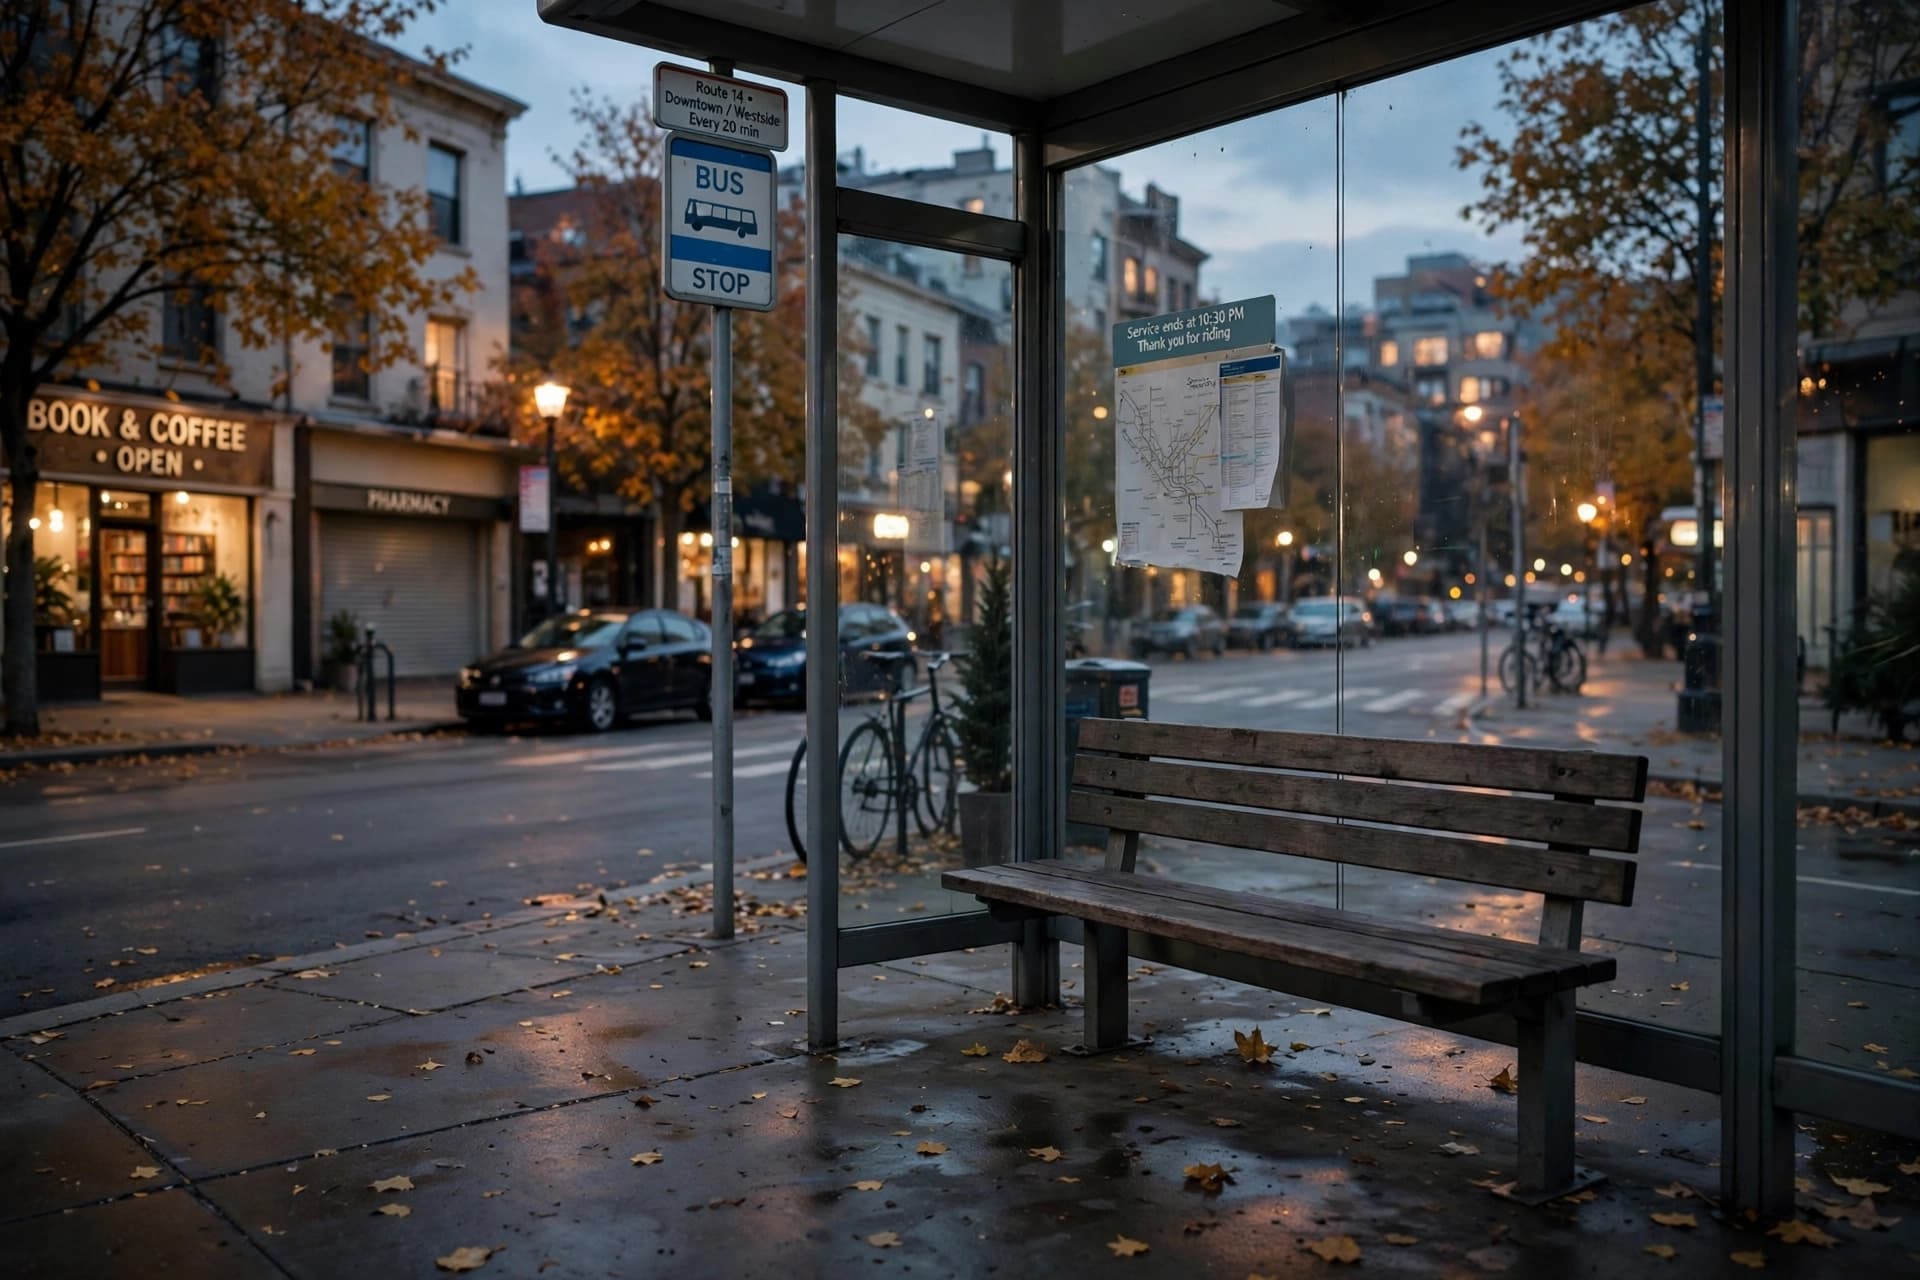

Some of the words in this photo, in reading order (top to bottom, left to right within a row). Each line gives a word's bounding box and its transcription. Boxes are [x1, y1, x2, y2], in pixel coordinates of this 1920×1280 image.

[696, 80, 728, 99] Route
[733, 89, 744, 104] 14
[665, 90, 723, 116] Downtown
[734, 105, 780, 127] Westside
[690, 112, 720, 133] Every
[722, 119, 736, 133] 20
[740, 125, 759, 138] min
[696, 165, 744, 195] BUS
[692, 267, 750, 295] STOP
[1127, 322, 1160, 339] Service
[1162, 316, 1184, 332] ends
[1186, 316, 1196, 328] at
[1198, 310, 1226, 327] 10:30
[1229, 306, 1244, 322] PM
[1137, 337, 1166, 353] Thank
[1167, 334, 1184, 351] you
[1186, 331, 1201, 344] for
[1202, 325, 1231, 342] riding
[27, 398, 110, 438] BOOK
[119, 408, 141, 441] &
[149, 412, 248, 452] COFFEE
[116, 445, 184, 477] OPEN
[367, 489, 451, 516] PHARMACY
